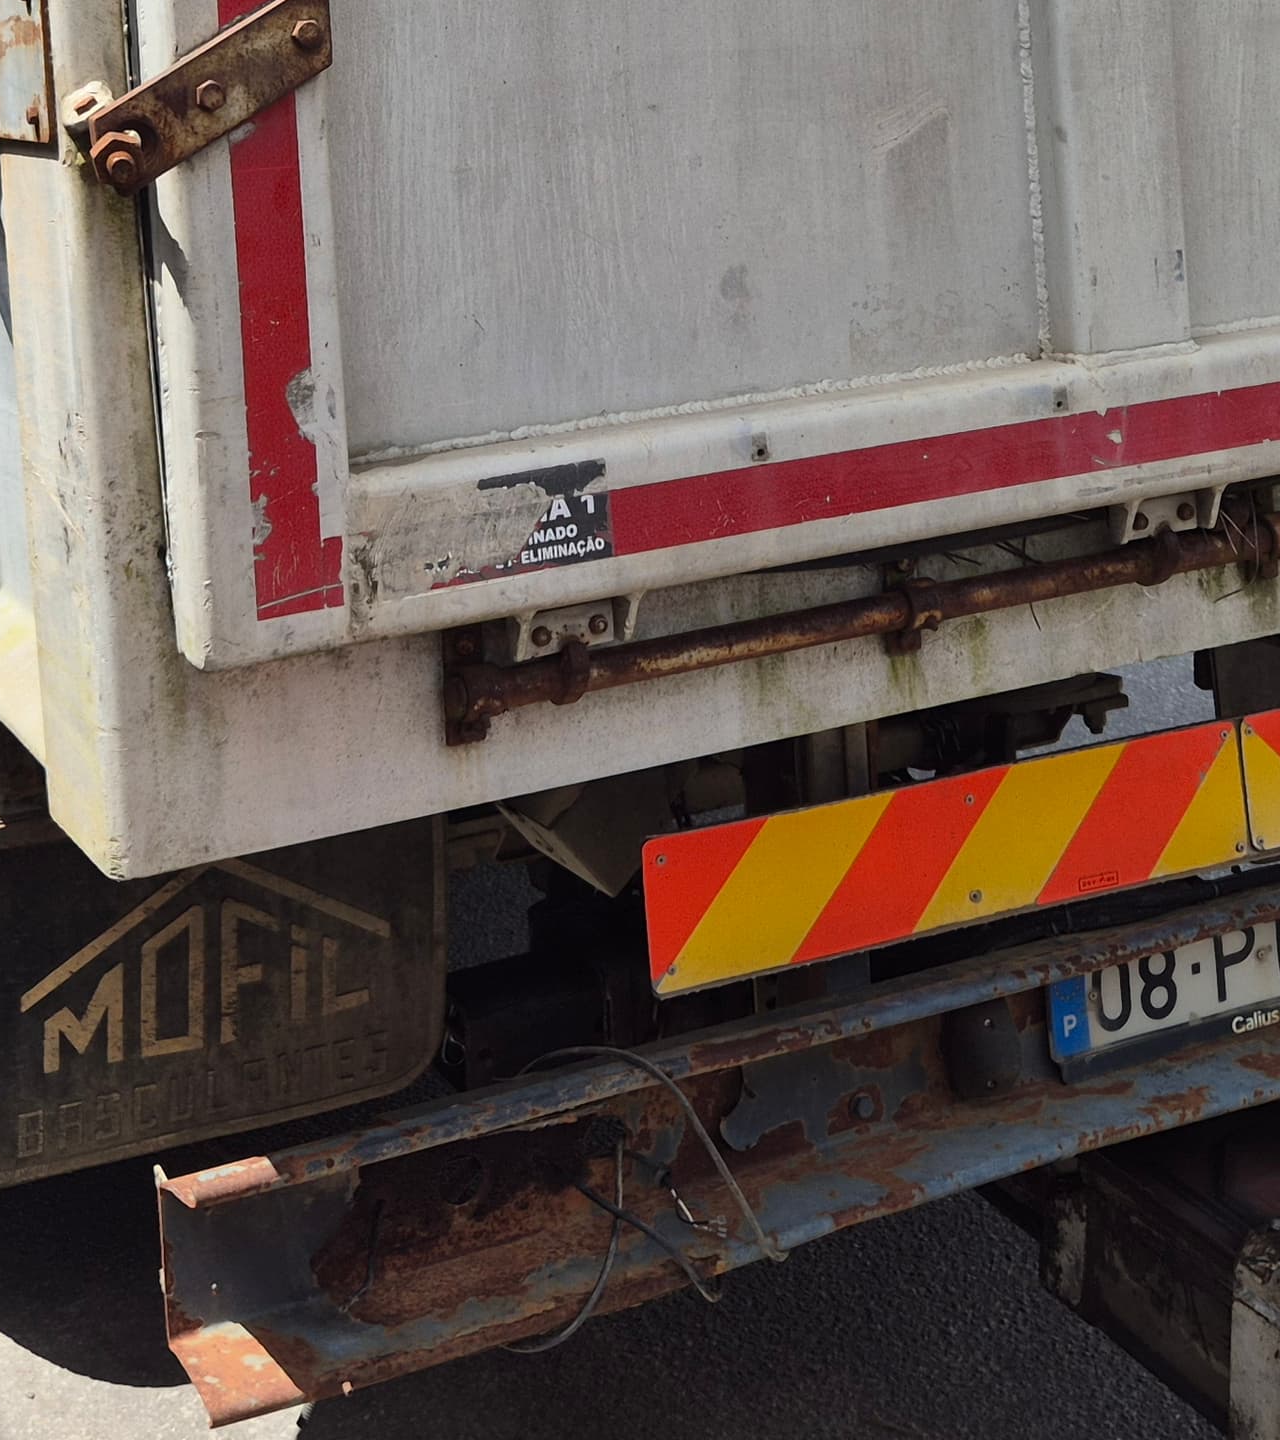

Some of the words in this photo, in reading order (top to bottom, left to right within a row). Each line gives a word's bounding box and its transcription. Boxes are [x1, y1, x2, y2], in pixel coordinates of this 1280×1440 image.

[541, 495, 572, 522] A
[581, 494, 595, 514] 1
[521, 536, 605, 564] ELIMINAÇÃO
[1063, 1014, 1077, 1038] P
[16, 1030, 390, 1159] BASCULANTES
